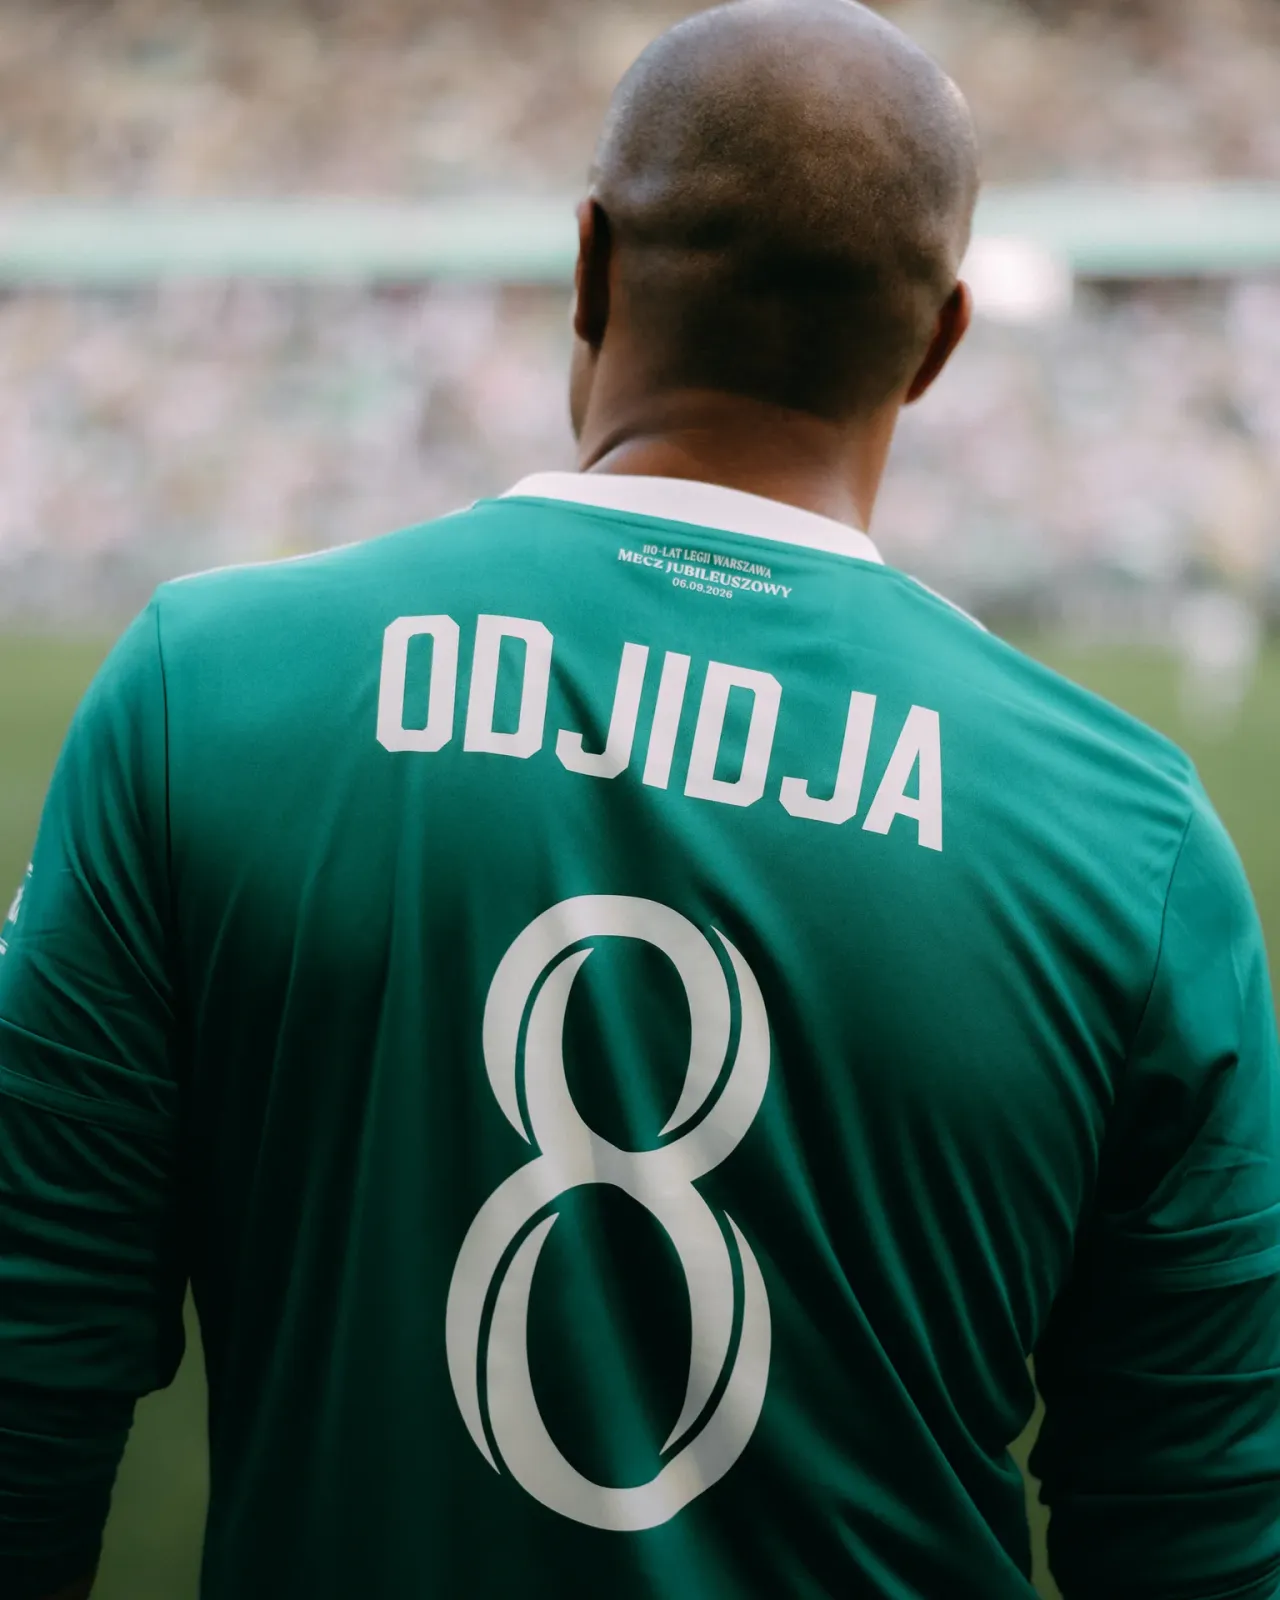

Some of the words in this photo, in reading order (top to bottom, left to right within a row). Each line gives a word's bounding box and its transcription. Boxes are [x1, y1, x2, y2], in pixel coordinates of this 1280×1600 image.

[617, 548, 663, 569] MECZ
[665, 561, 793, 598] JUBILEUSZOWY
[672, 577, 733, 599] 06.09.2026
[684, 549, 711, 565] LEGII
[713, 554, 772, 579] WARSZAWA
[376, 613, 944, 852] ODJIDJA
[445, 895, 772, 1532] 8
